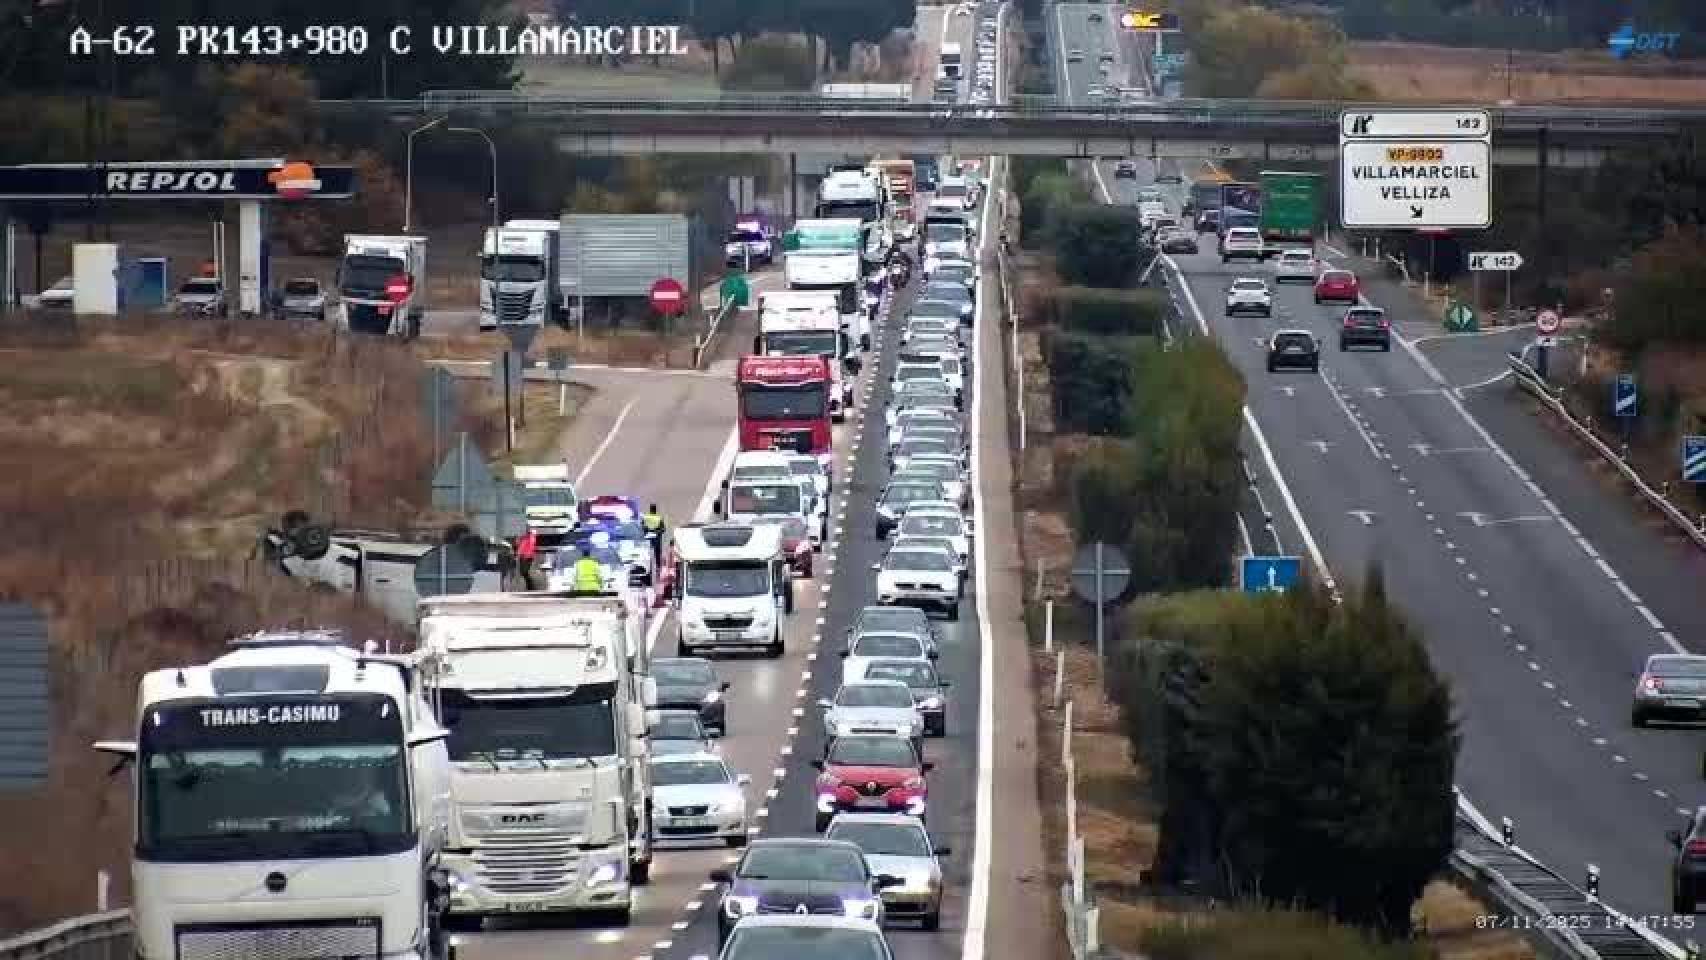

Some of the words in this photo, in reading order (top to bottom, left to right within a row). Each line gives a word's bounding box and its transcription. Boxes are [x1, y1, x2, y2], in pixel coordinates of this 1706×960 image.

[1352, 165, 1481, 179] VILLAMARCIEL
[106, 171, 236, 191] REPSOL
[1380, 185, 1451, 201] VELLIZA
